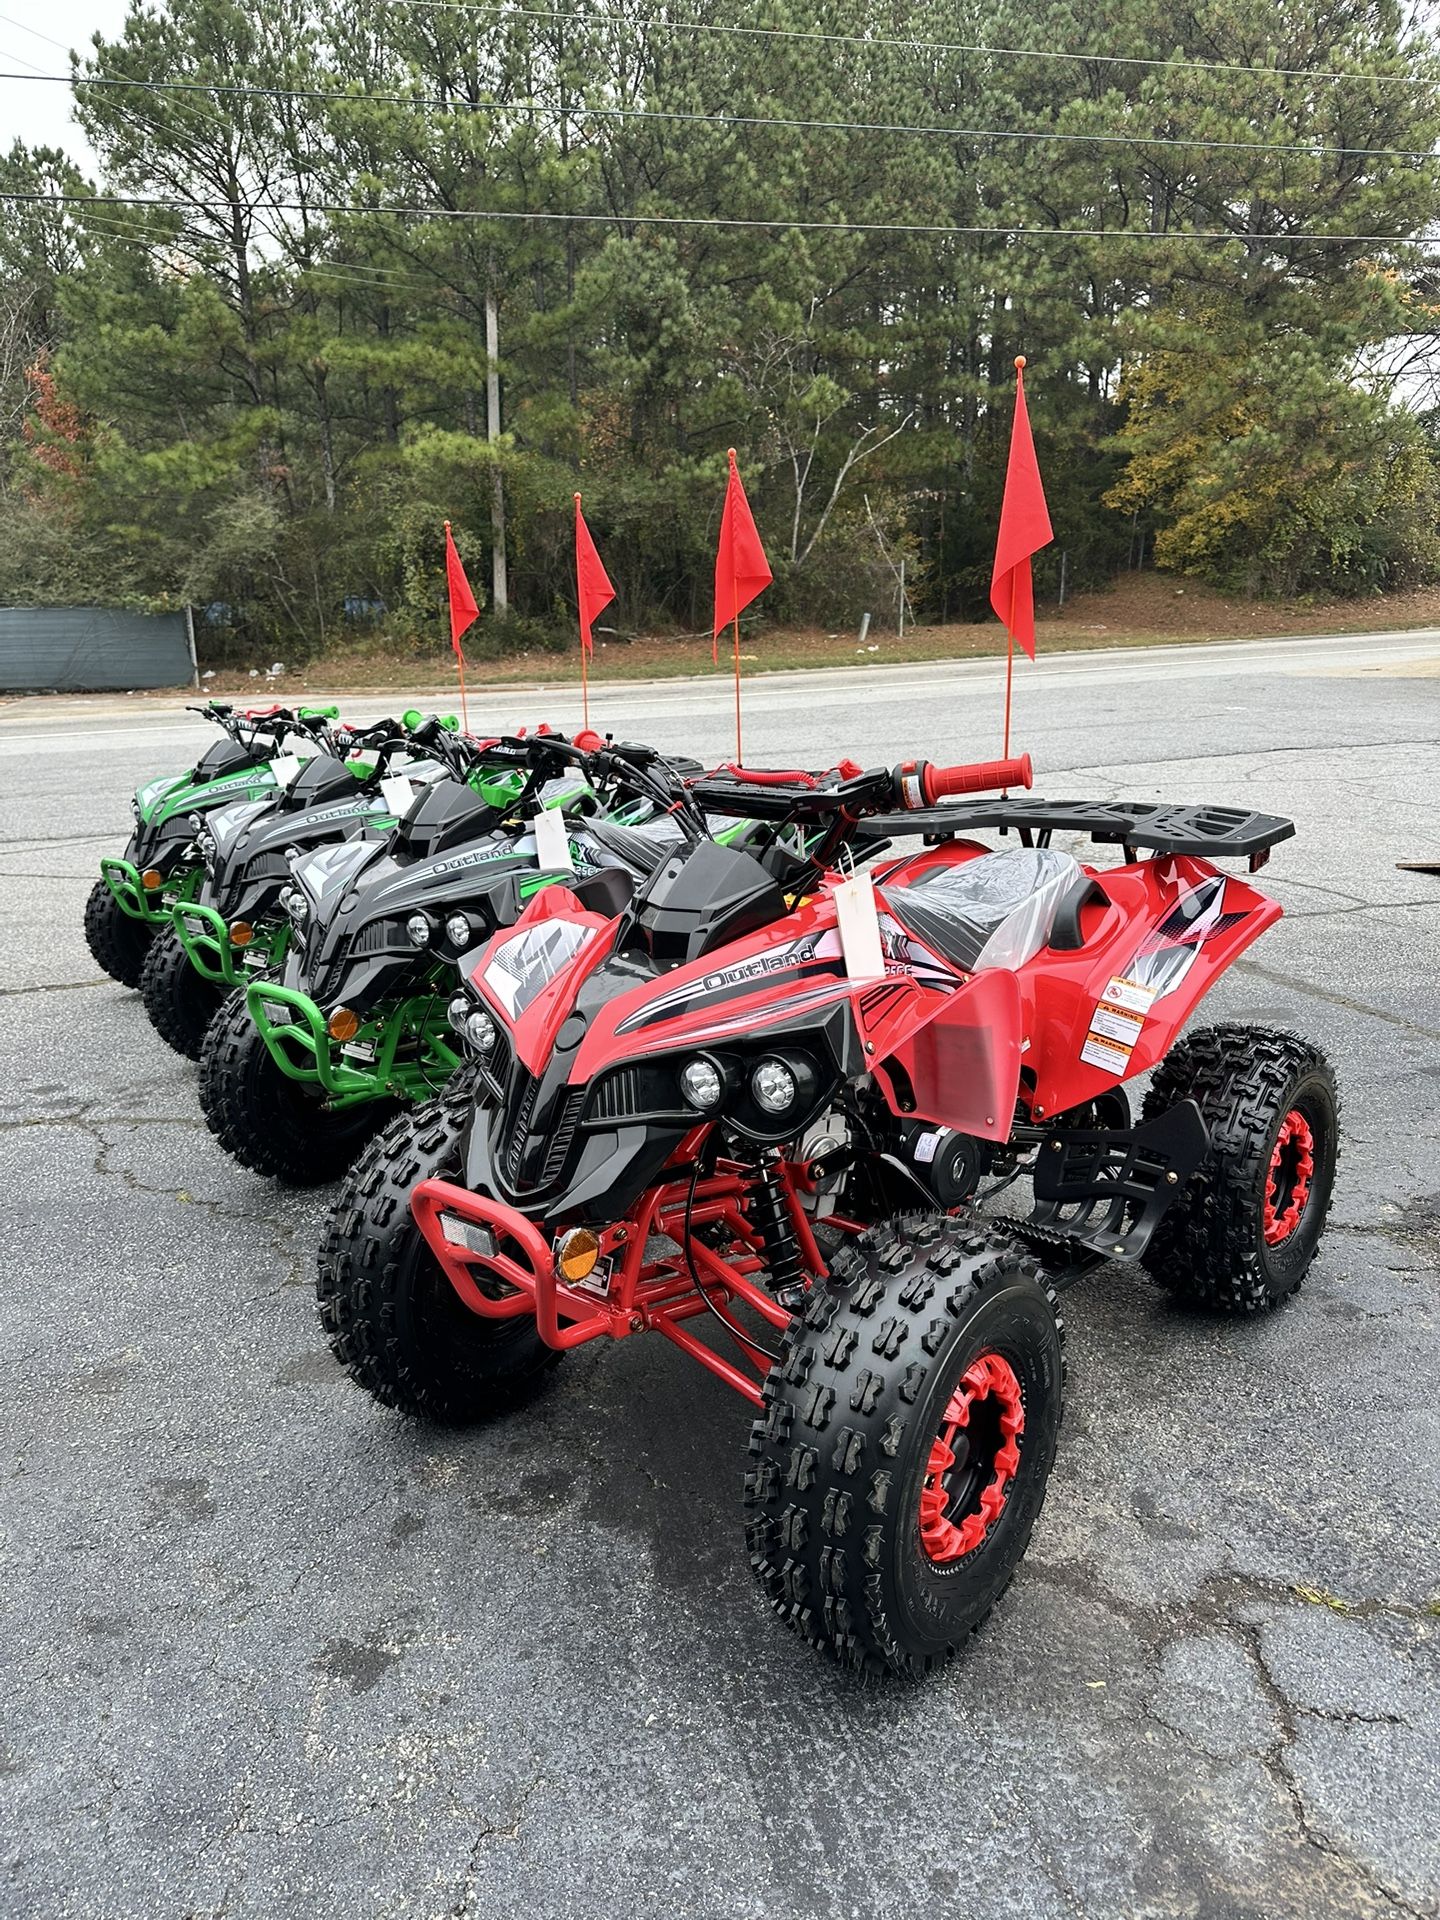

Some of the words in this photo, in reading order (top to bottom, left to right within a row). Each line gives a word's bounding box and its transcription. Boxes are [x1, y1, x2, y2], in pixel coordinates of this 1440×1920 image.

[208, 777, 261, 793] Outland
[306, 802, 370, 824] Outland
[432, 843, 514, 875] Outland
[570, 841, 588, 863] AX
[702, 944, 815, 991] Outland
[1111, 1008, 1138, 1021] WARNING
[1100, 1039, 1126, 1052] WARNING
